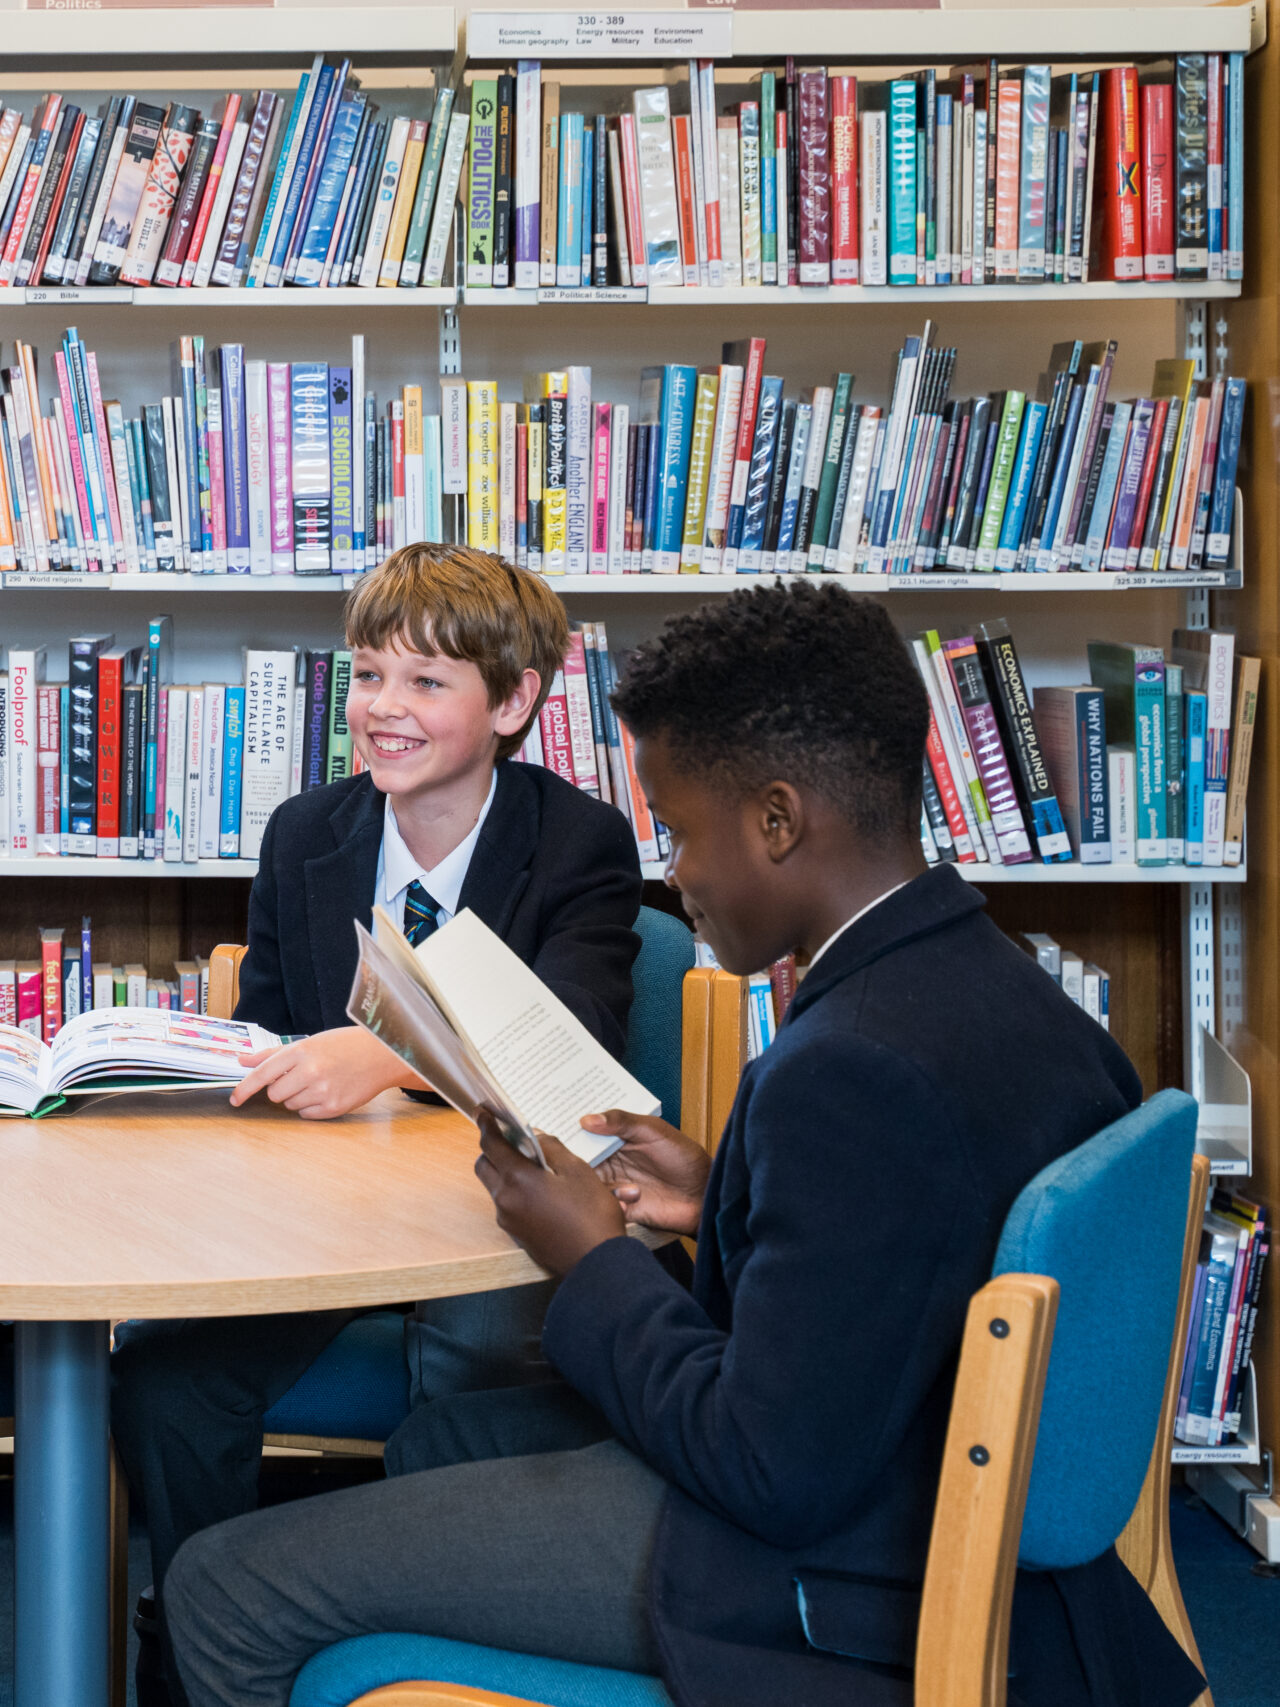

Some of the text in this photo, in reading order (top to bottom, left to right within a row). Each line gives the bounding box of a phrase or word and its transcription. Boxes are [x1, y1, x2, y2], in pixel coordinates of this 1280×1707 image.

[528, 38, 569, 46] geography
[611, 38, 640, 46] Military
[654, 37, 693, 45] Education
[576, 28, 603, 37] Energy
[578, 16, 596, 25] 330
[606, 16, 624, 25] 389
[474, 126, 493, 136] THE
[1184, 57, 1205, 160] Politics UK
[471, 138, 493, 220] POLITICS
[1150, 153, 1166, 218] Disorder
[136, 216, 153, 250] BIBLE
[151, 219, 161, 235] the
[471, 221, 491, 229] BOOK
[839, 186, 848, 246] TIM MARSHALL
[229, 355, 239, 387] Collins
[480, 389, 489, 406] get
[551, 400, 563, 440] British
[333, 416, 349, 425] THE
[578, 395, 588, 449] CAROLINE
[826, 414, 845, 464] DEMOCRACY
[249, 412, 261, 486] SOCIOLOGY
[451, 433, 459, 467] MINUTES
[479, 421, 491, 466] together
[550, 442, 562, 486] Politics
[332, 428, 351, 518] SOCIOLOGY
[1085, 443, 1105, 507] PANKHURST
[480, 495, 490, 540] williams
[567, 455, 586, 553] Another ENGLAND
[595, 502, 604, 549] RICK EDWARDS
[29, 575, 52, 583] World
[53, 576, 83, 585] religions
[898, 577, 969, 587] 323.1 Human rights
[333, 660, 351, 735] FILTERWORLD
[1213, 645, 1228, 720] economics
[14, 667, 28, 746] Foolproof
[192, 698, 200, 717] HOW
[248, 671, 259, 754] CAPITALISM
[261, 662, 274, 765] SURVEILLANCE
[275, 675, 288, 752] THE AGE OF
[549, 702, 568, 748] global
[999, 641, 1048, 791] ECONOMICS EXPLAINED
[210, 729, 218, 743] Bias
[1151, 703, 1163, 757] economics
[191, 741, 199, 765] RIGHT
[208, 746, 216, 770] Jessica
[227, 747, 237, 766] Chip
[1086, 698, 1104, 838] WHY NATIONS FAIL
[1138, 714, 1152, 804] global perspective
[1153, 759, 1163, 783] from
[227, 779, 235, 796] Dan
[227, 799, 235, 824] Heath
[6, 984, 15, 1003] MEN
[44, 960, 59, 1008] fed up.
